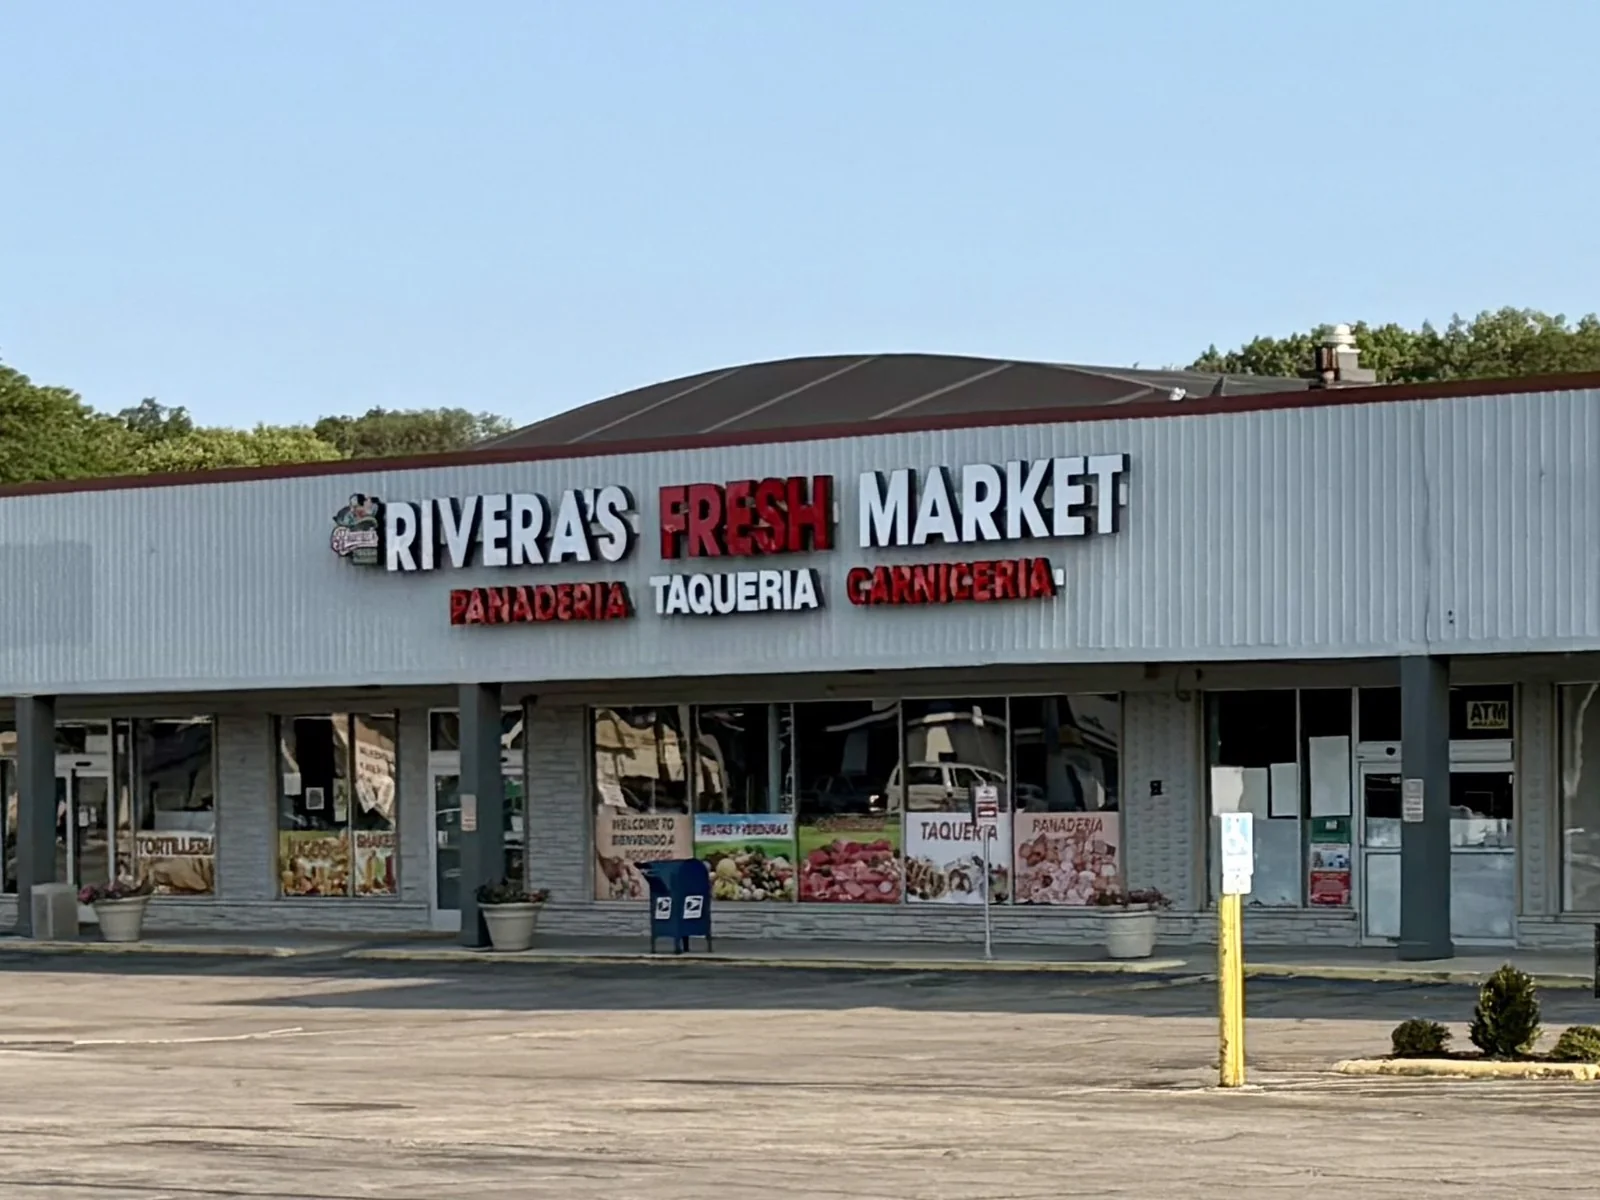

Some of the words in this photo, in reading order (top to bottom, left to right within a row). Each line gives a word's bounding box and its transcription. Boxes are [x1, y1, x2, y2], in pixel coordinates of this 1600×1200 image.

[386, 485, 629, 571] RIVERA'S
[659, 475, 833, 559] FRESH
[859, 453, 1124, 548] MARKET
[450, 580, 629, 626] PANADERIA
[649, 568, 819, 615] TAQUERIA
[847, 558, 1054, 606] CARNICERIA
[1470, 703, 1506, 721] ATM
[612, 817, 659, 830] WELCOME
[661, 817, 675, 830] TO
[921, 822, 998, 841] TAQUERA
[1032, 818, 1104, 834] PANADERIA
